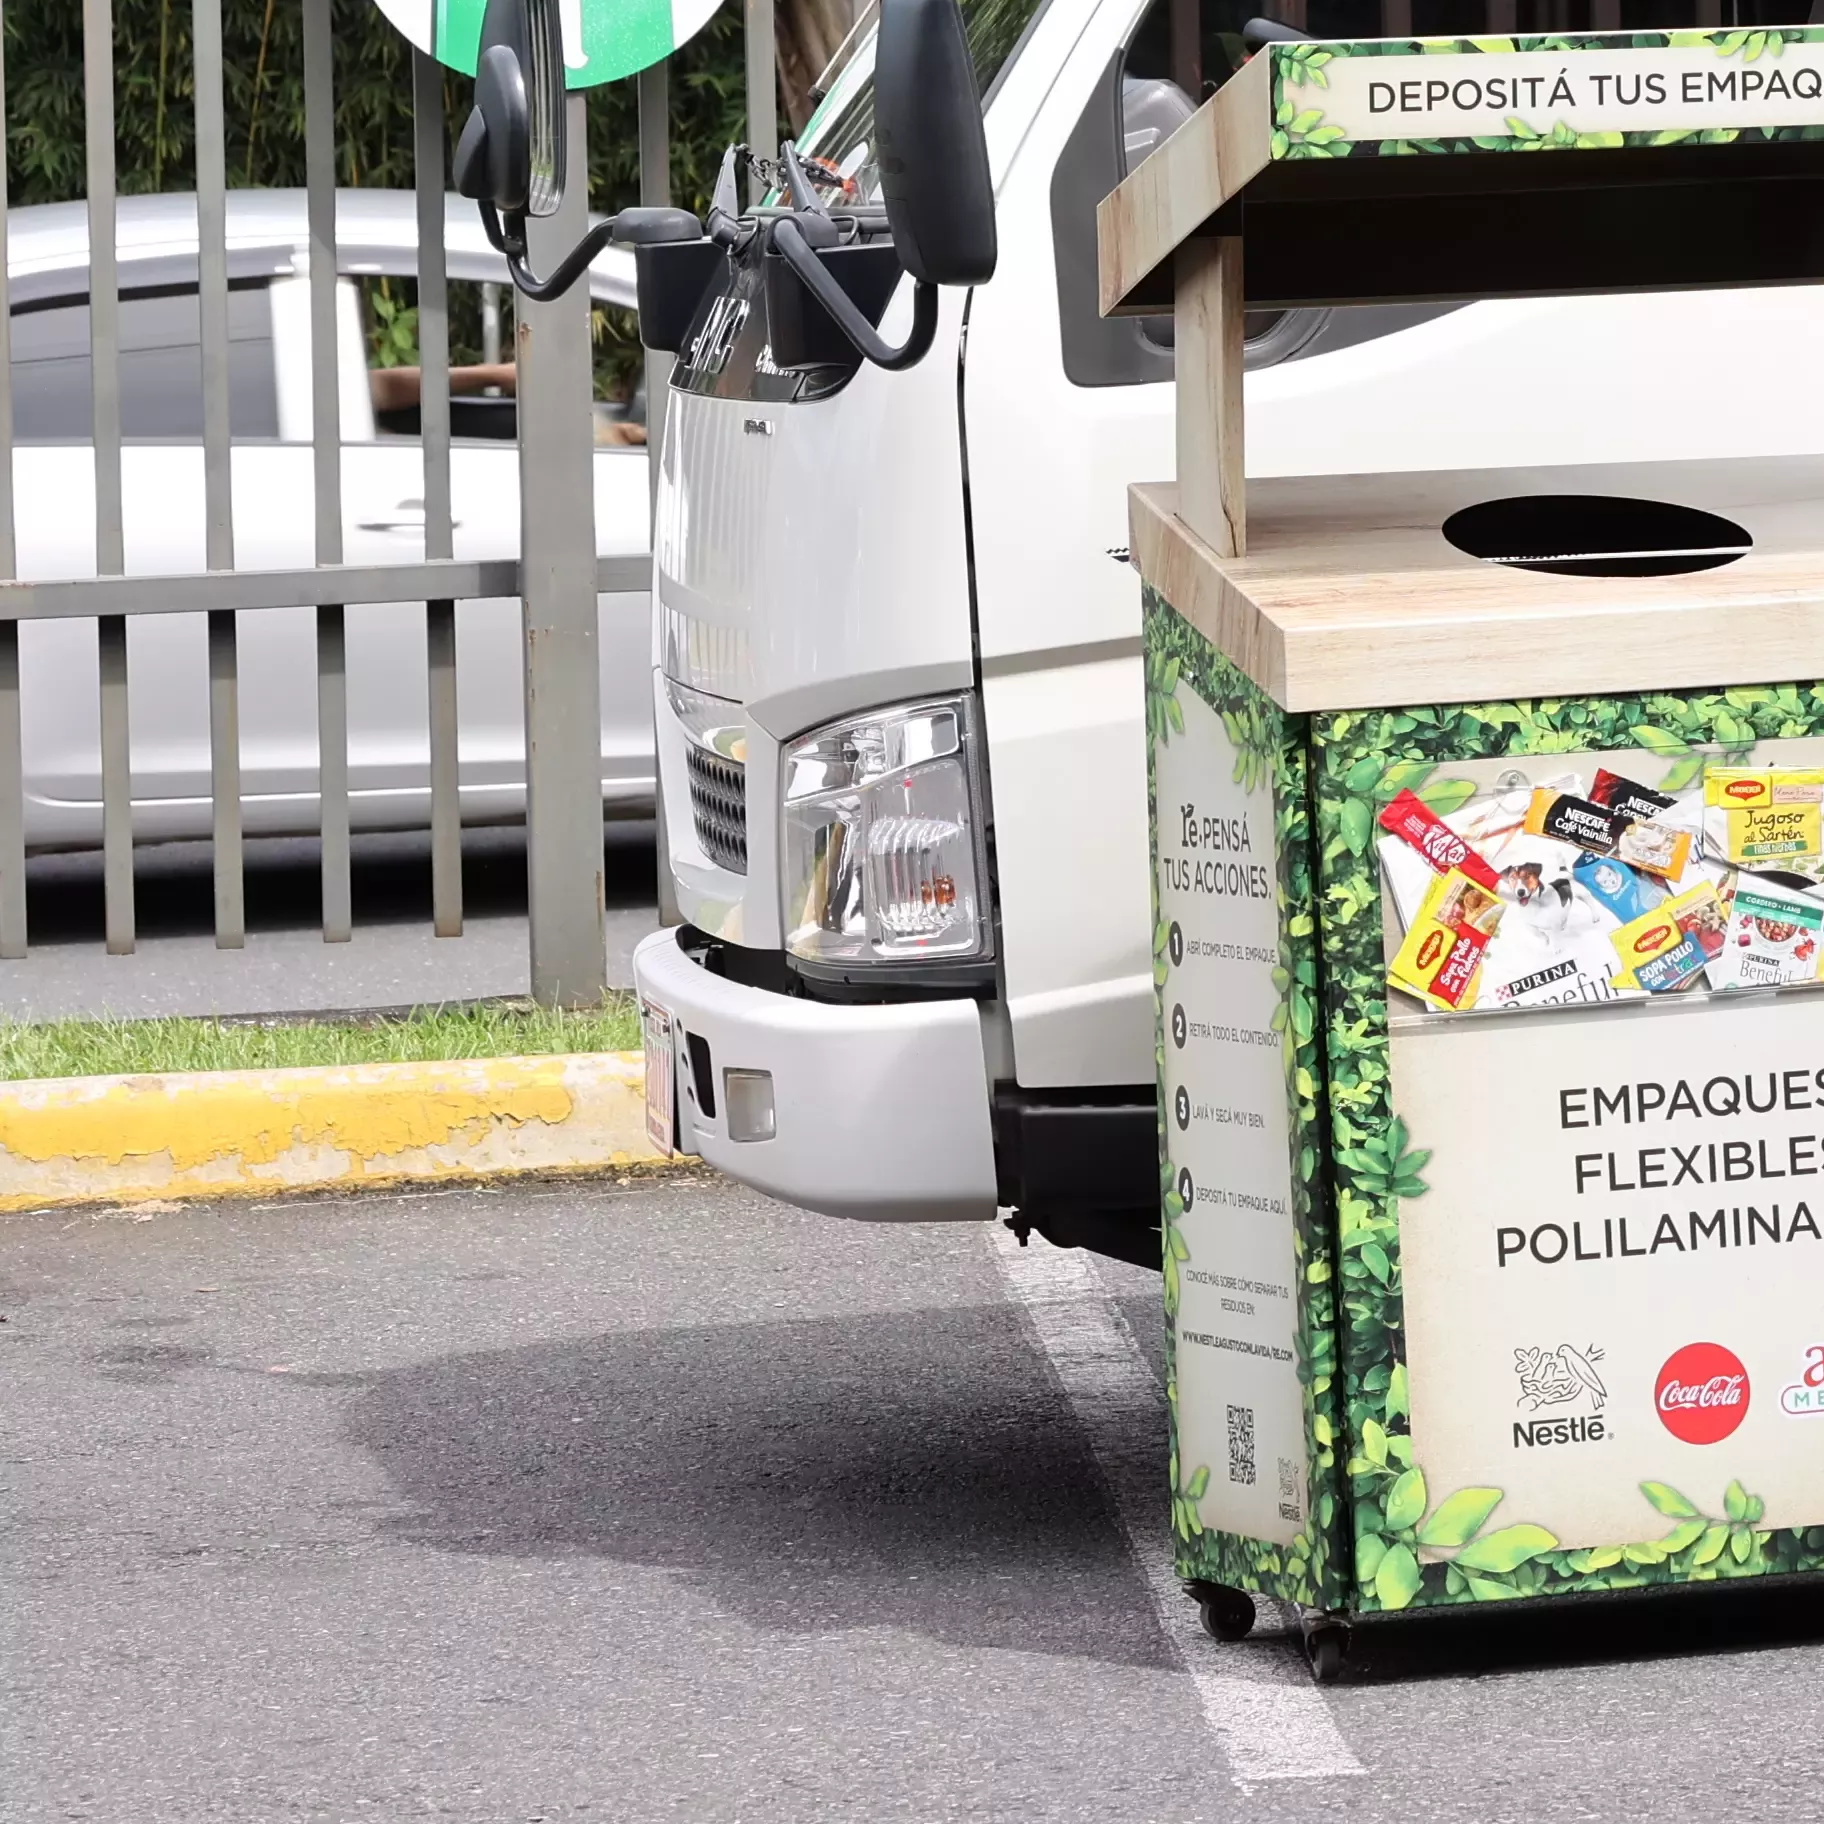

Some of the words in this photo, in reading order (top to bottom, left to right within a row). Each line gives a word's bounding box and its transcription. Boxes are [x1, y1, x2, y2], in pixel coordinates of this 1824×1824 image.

[1367, 68, 1576, 114] DEPOSITÁ
[1589, 72, 1667, 107] TUS
[1555, 817, 1577, 834] Café
[1578, 824, 1613, 845] Vainilla
[1744, 809, 1806, 831] Jugoso
[1744, 831, 1757, 844] al
[1163, 857, 1190, 891] TUS
[1194, 860, 1272, 899] ACCIONES.
[1186, 938, 1201, 956] ABRÍ
[1202, 941, 1236, 960] COMPLETO
[1236, 945, 1244, 960] EL
[1440, 962, 1458, 986] Sopa
[1450, 937, 1471, 961] Pollo
[1640, 959, 1667, 982] SOPA
[1664, 941, 1694, 966] POLLO
[1510, 962, 1575, 995] PURINA
[1651, 973, 1665, 987] CON
[1189, 1022, 1212, 1039] RETIRÁ
[1212, 1025, 1231, 1042] TODO
[1231, 1028, 1240, 1043] EL
[1192, 1103, 1210, 1121] LAVÁ
[1215, 1106, 1232, 1124] SECÁ
[1233, 1111, 1247, 1127] MUY
[1196, 1186, 1227, 1207] DEPOSITÁ
[1228, 1191, 1237, 1207] TU
[1237, 1193, 1269, 1213] EMPAQUE
[1220, 1275, 1237, 1290] SOBRE
[1513, 1414, 1605, 1448] Nestlé
